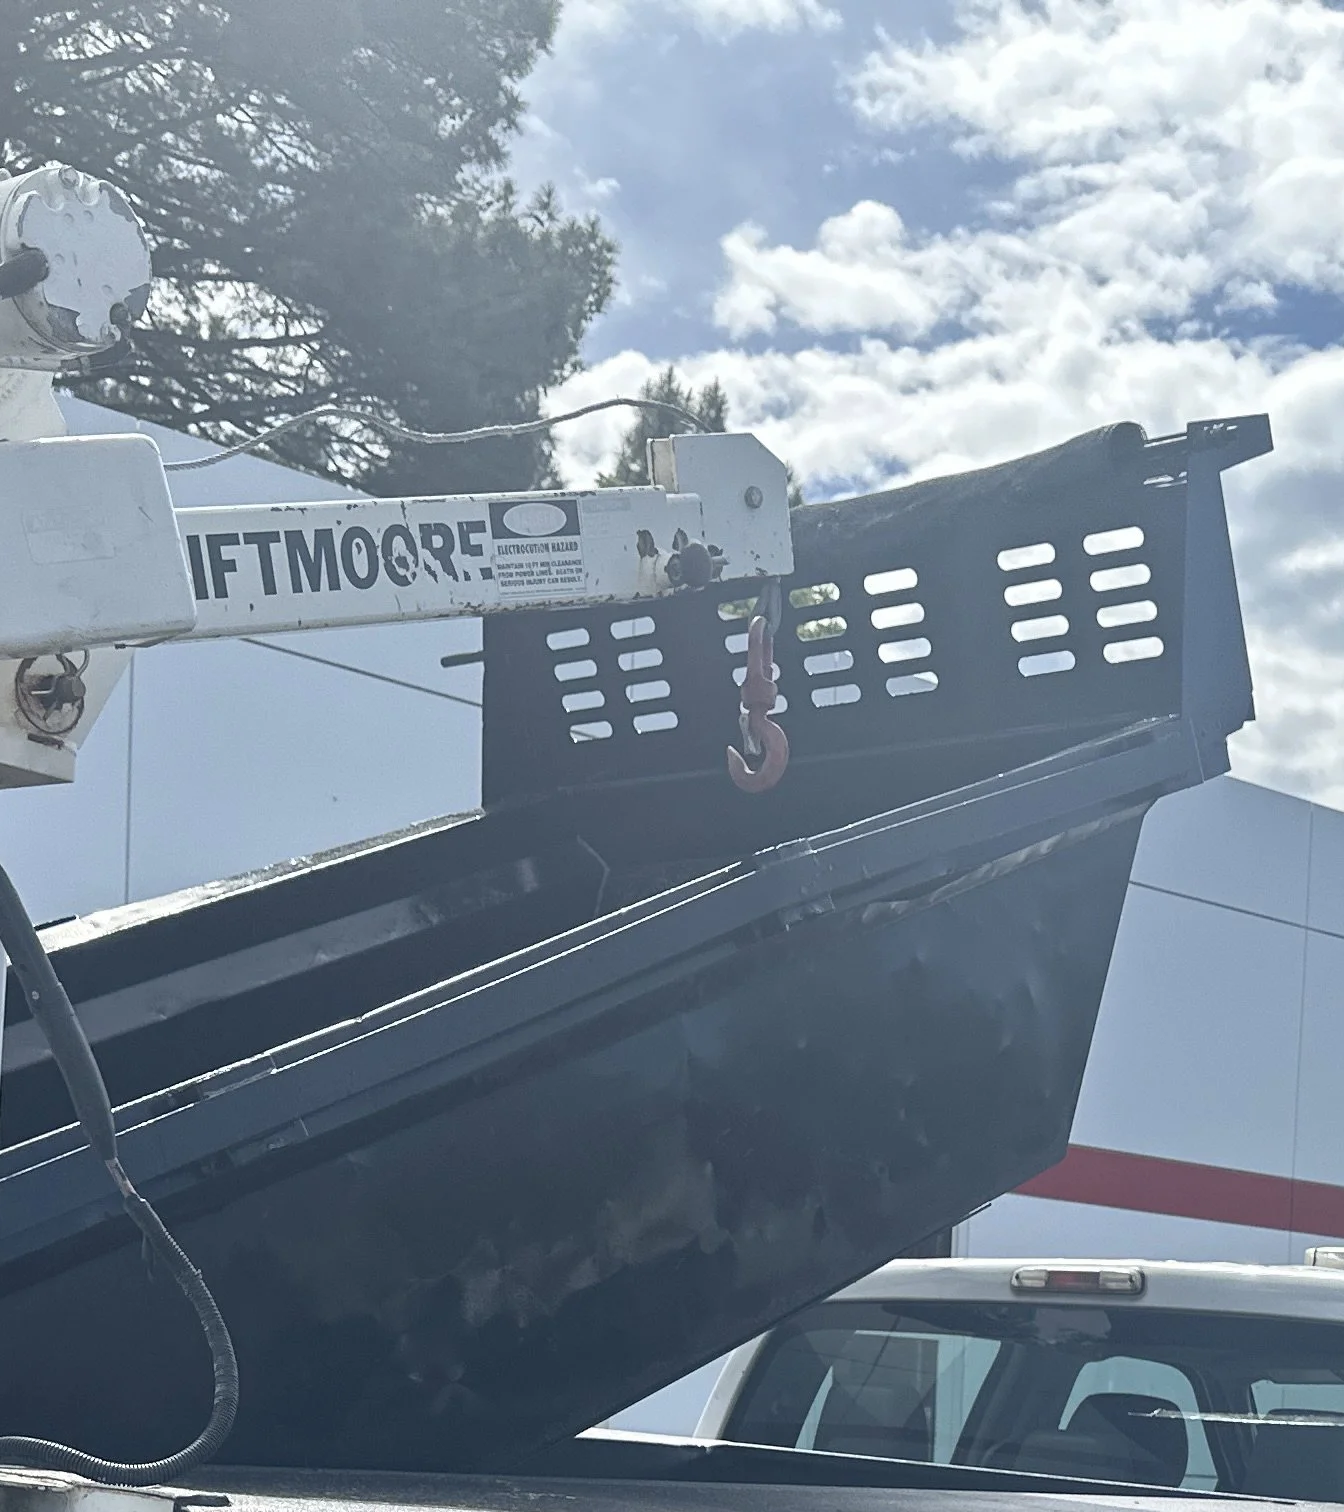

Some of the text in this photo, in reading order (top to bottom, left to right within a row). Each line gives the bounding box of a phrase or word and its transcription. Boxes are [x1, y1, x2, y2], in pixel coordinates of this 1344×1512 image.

[186, 519, 494, 600] IFTMOORE
[497, 541, 579, 556] ELECTROCUTION HAZARD
